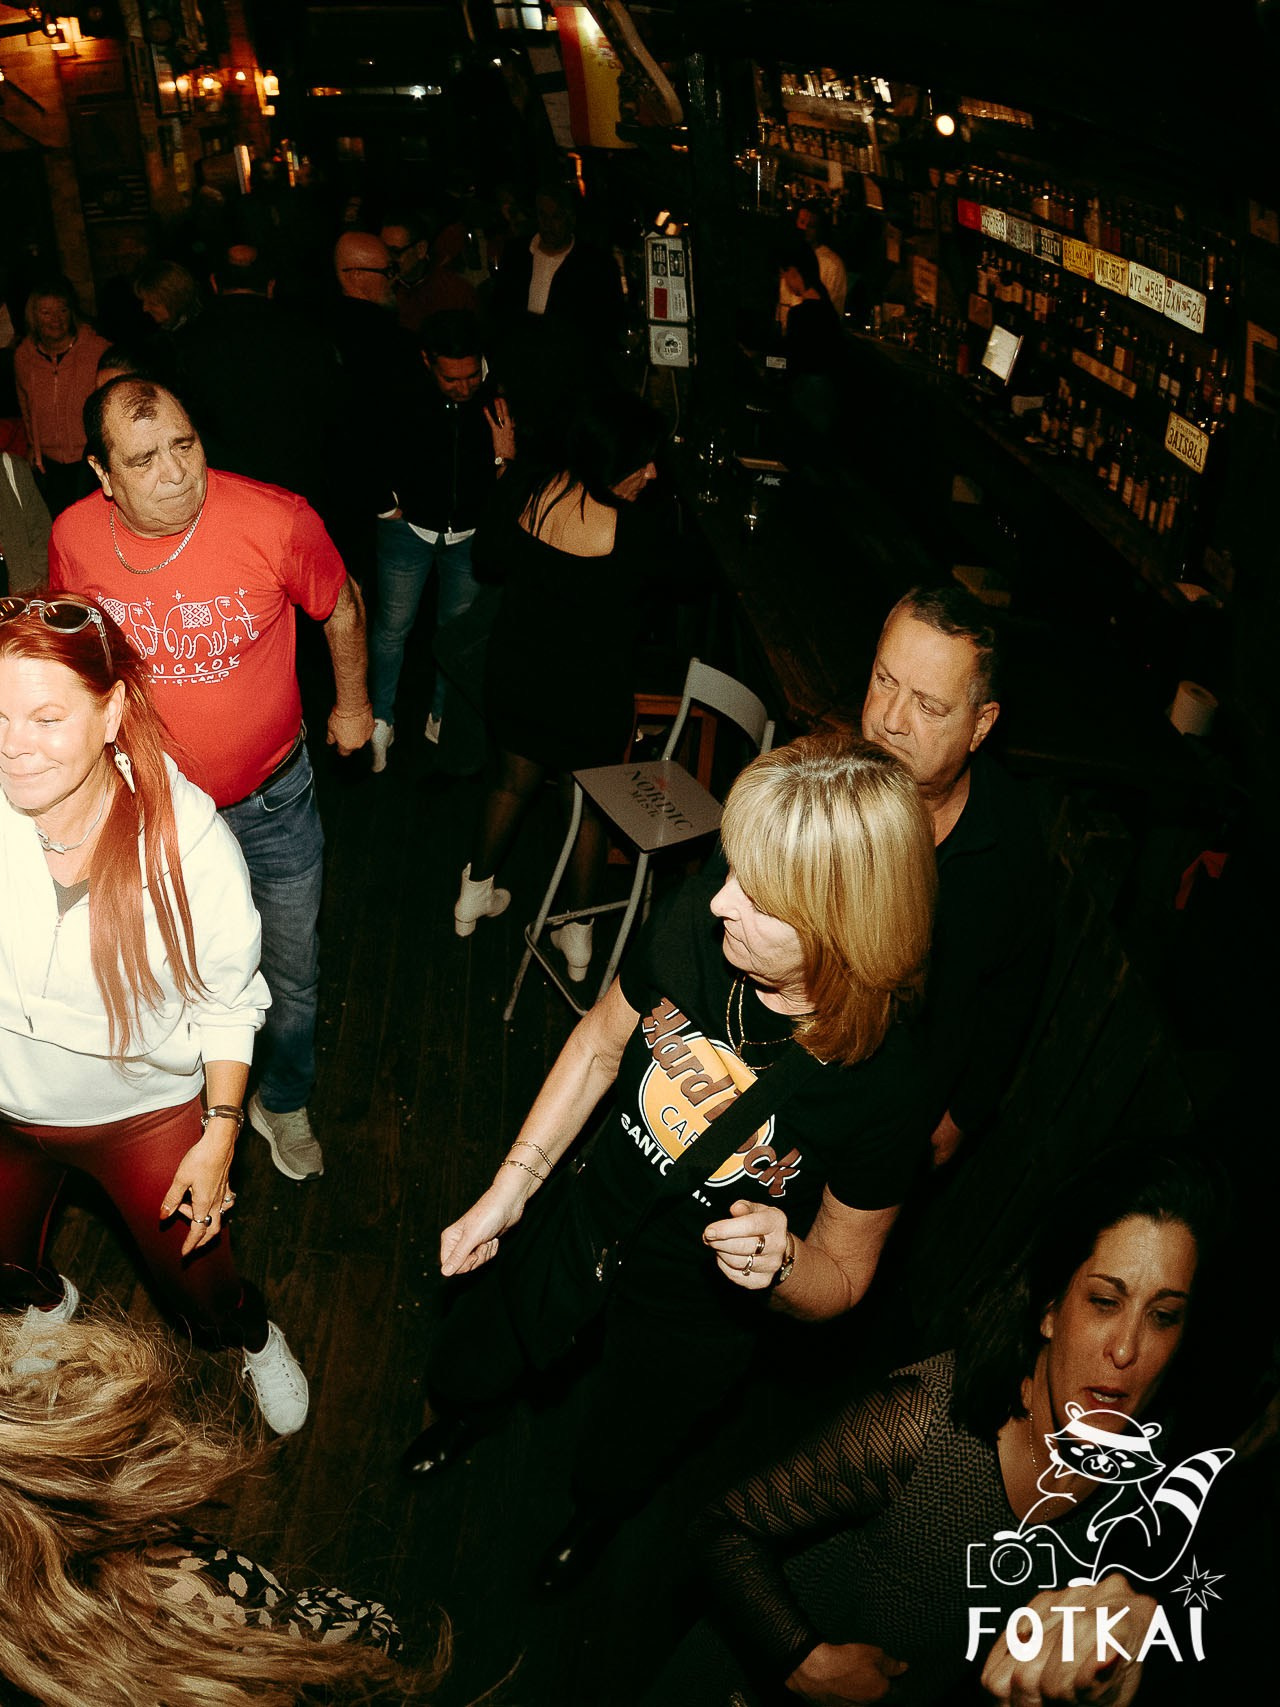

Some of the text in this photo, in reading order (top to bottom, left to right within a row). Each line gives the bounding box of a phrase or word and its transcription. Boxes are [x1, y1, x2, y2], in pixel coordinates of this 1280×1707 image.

[1150, 281, 1163, 303] 595
[1165, 289, 1181, 313] ZXN
[1186, 300, 1202, 325] 526
[152, 653, 241, 675] NGKOK
[642, 996, 736, 1107] Hard
[661, 1104, 701, 1148] CAF
